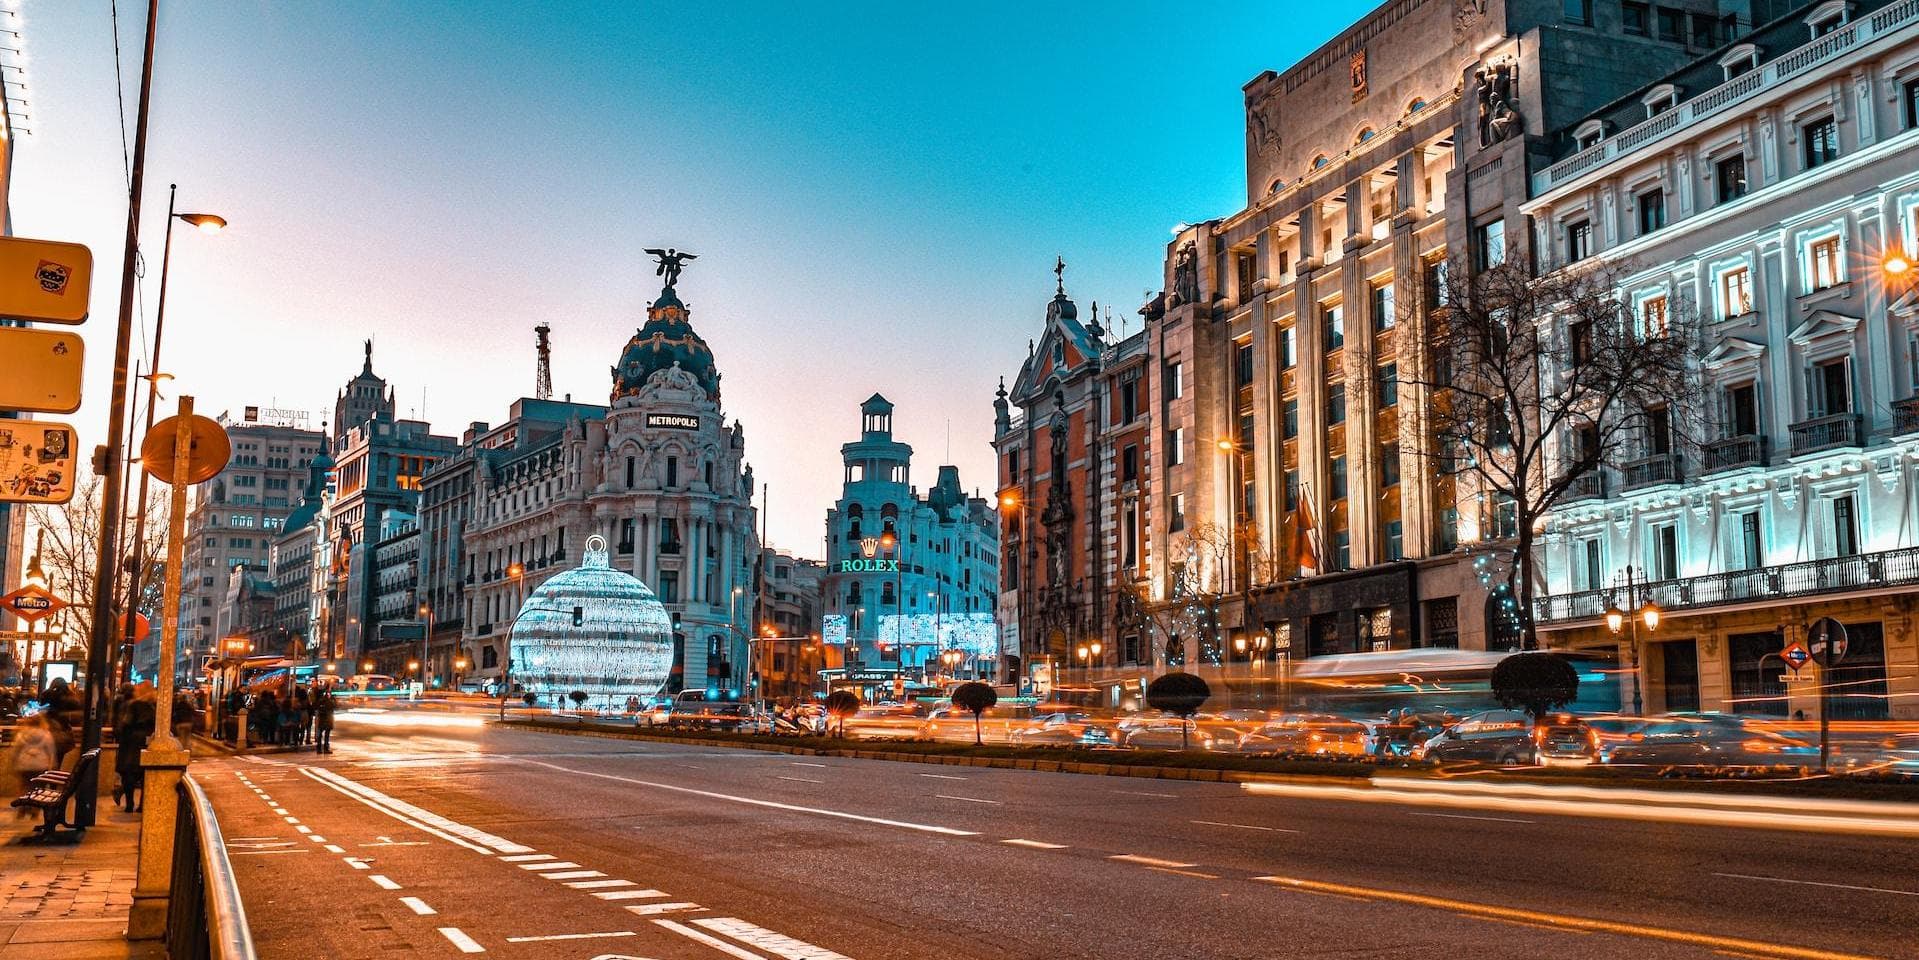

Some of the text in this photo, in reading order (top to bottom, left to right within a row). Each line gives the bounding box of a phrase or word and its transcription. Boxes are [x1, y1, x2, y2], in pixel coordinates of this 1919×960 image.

[649, 416, 698, 428] METROPOLIS
[841, 559, 899, 573] ROLEX
[17, 598, 47, 608] Metro
[1021, 677, 1030, 690] P
